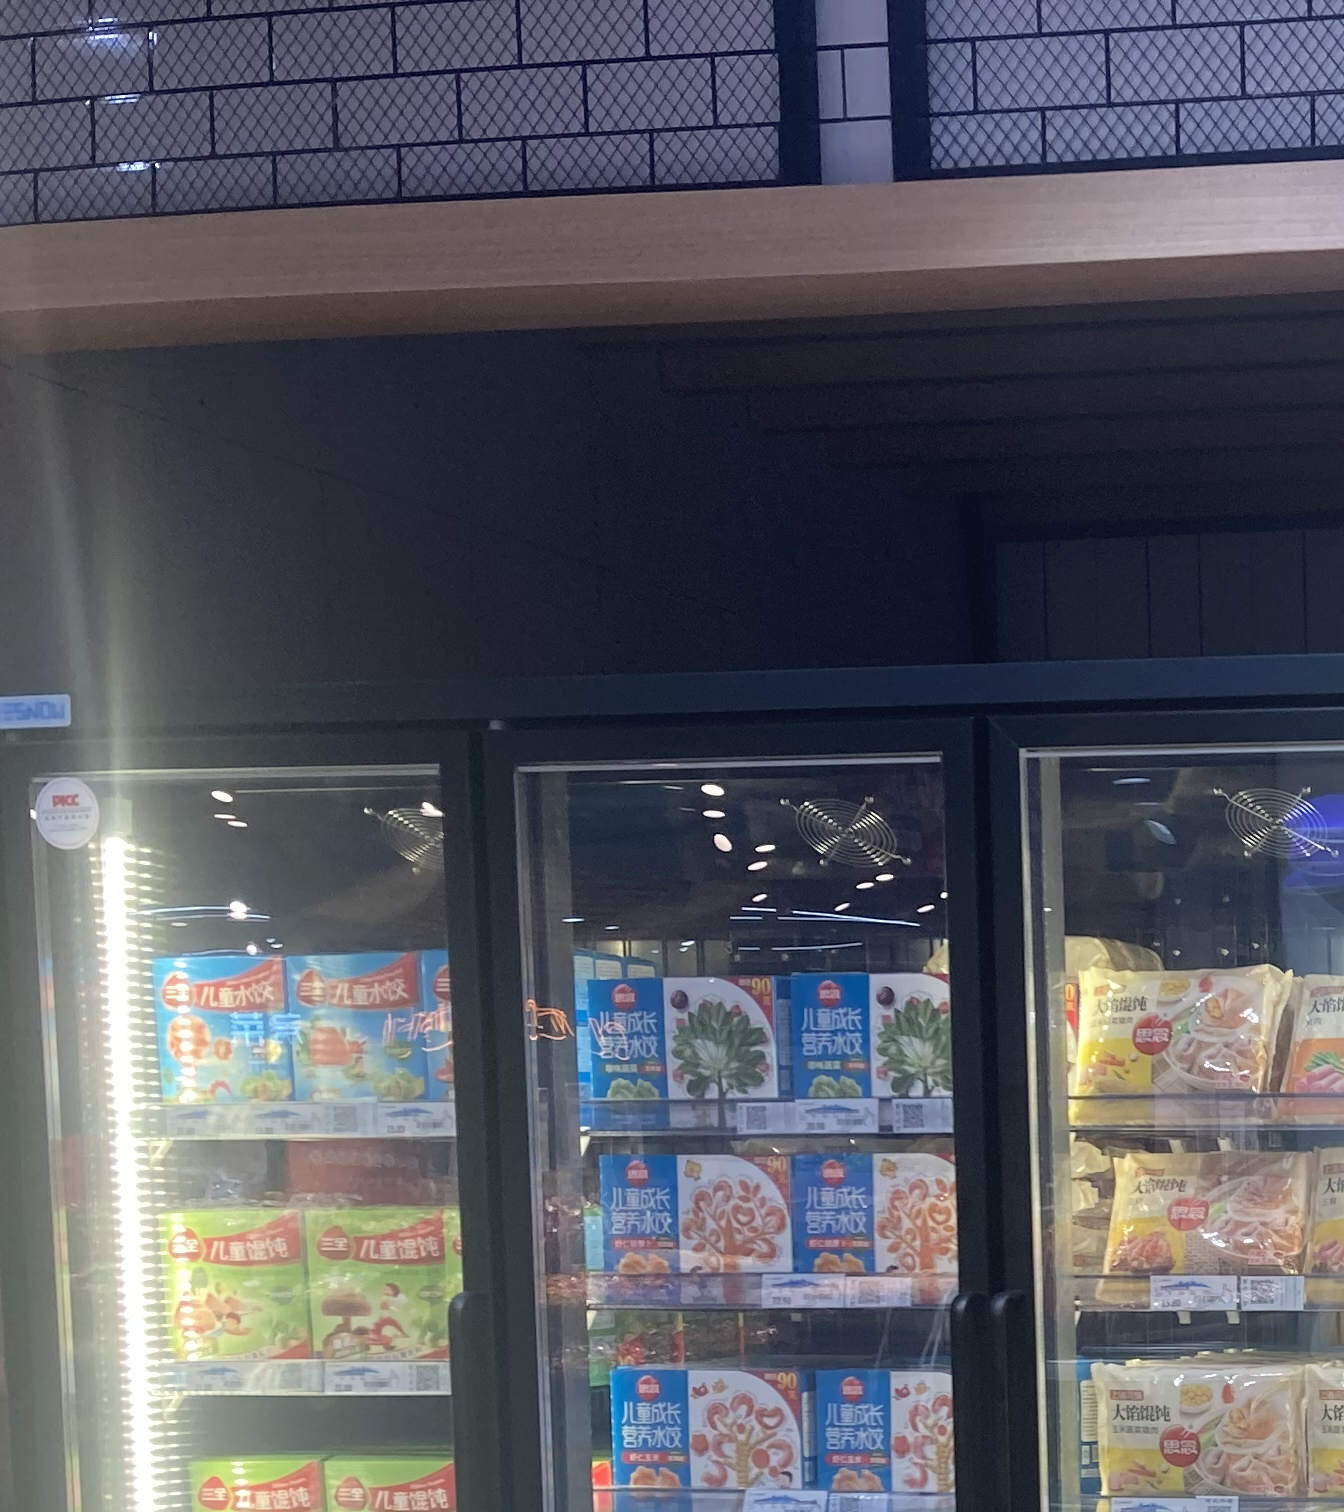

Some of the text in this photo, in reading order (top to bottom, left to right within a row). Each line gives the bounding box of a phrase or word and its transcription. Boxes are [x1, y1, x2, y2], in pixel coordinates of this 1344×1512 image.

[201, 984, 275, 1008] 儿童水饺
[335, 979, 408, 1006] 儿童水饺
[802, 1008, 862, 1032] 儿童成长
[802, 1033, 862, 1058] 营养水饺
[609, 1188, 670, 1210] 儿童成长
[805, 1187, 866, 1211] 儿童成长
[611, 1211, 672, 1235] 营养水饺
[806, 1211, 866, 1235] 营养水饺
[210, 1237, 288, 1261] 儿童馄饨
[360, 1235, 439, 1259] 儿童馄饨
[621, 1402, 681, 1425] 儿童成长
[825, 1403, 884, 1426] 儿童成长
[1112, 1404, 1171, 1423] 大馅馄饨
[622, 1426, 682, 1450] 营养水饺
[826, 1427, 884, 1451] 营养水饺
[1163, 1439, 1198, 1456] 思念
[202, 1488, 226, 1501] 三全
[338, 1488, 364, 1501] 三全
[375, 1488, 449, 1512] 儿童馄饨
